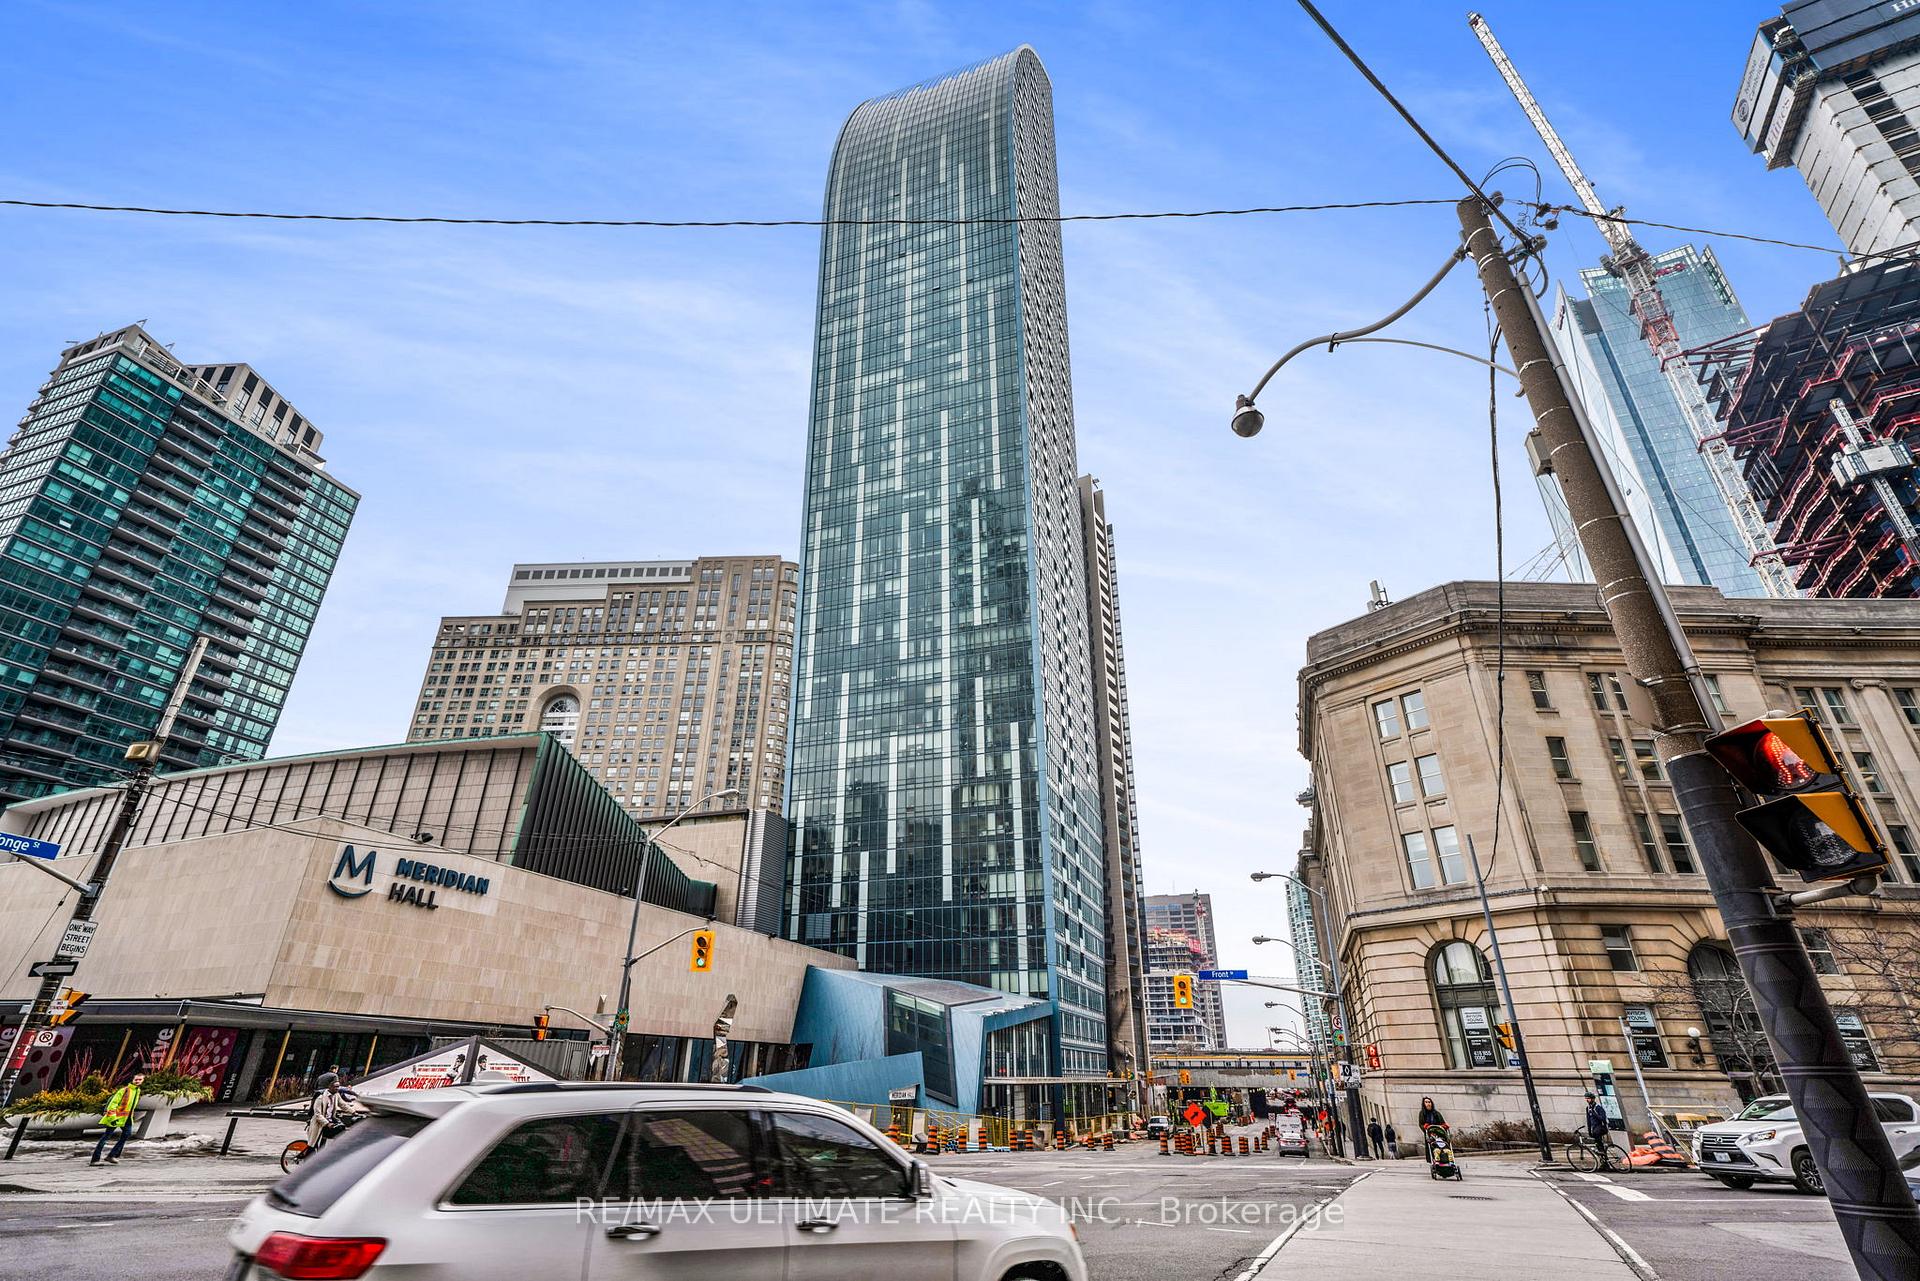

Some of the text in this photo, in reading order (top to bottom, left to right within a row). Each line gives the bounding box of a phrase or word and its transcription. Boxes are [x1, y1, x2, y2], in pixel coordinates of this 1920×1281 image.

[395, 858, 490, 895] MERIDIAN
[388, 882, 438, 910] HALL
[69, 923, 96, 934] ONE WAY
[65, 933, 90, 943] STREET
[60, 943, 86, 954] BEGINS
[1211, 970, 1229, 978] Front
